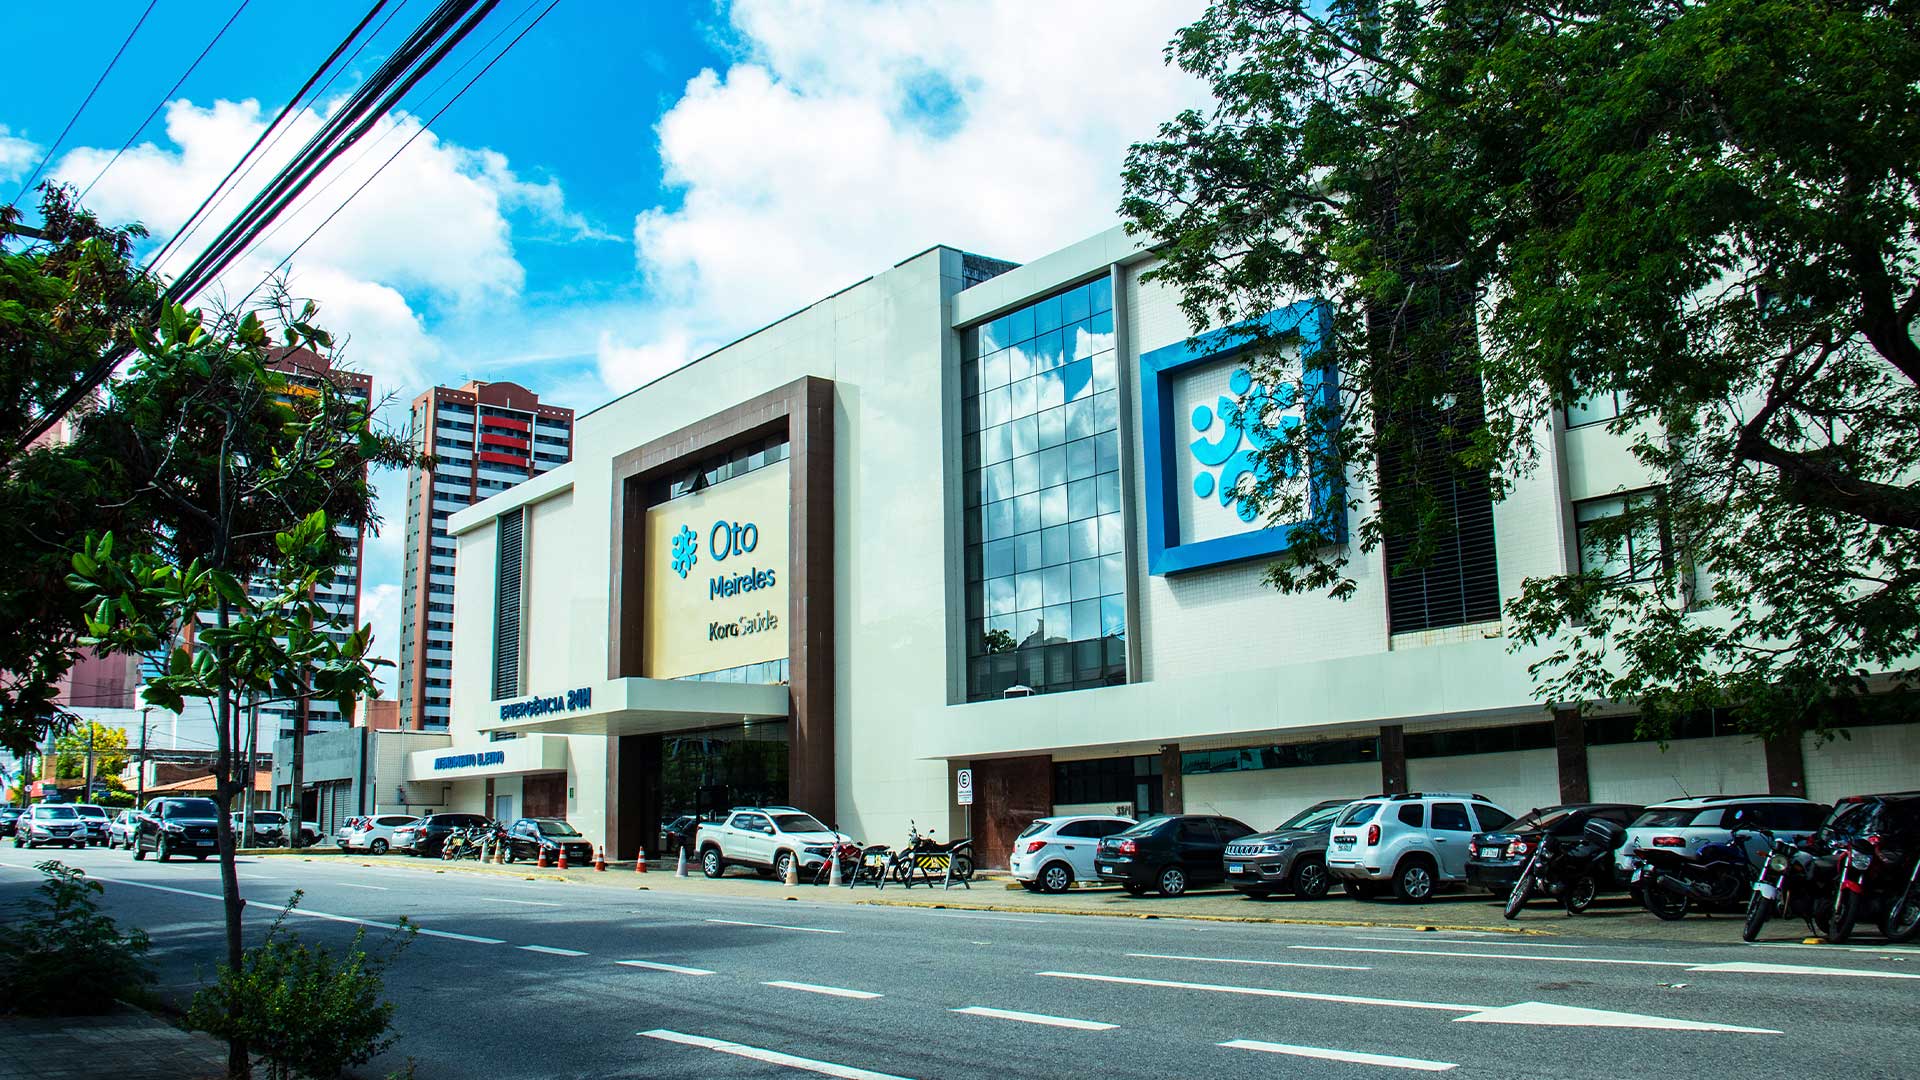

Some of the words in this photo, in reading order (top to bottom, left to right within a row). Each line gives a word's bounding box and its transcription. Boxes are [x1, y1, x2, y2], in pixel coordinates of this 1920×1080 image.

[709, 520, 758, 561] Oto
[709, 567, 776, 601] Meireles
[500, 696, 565, 721] EMERGÊNCIA
